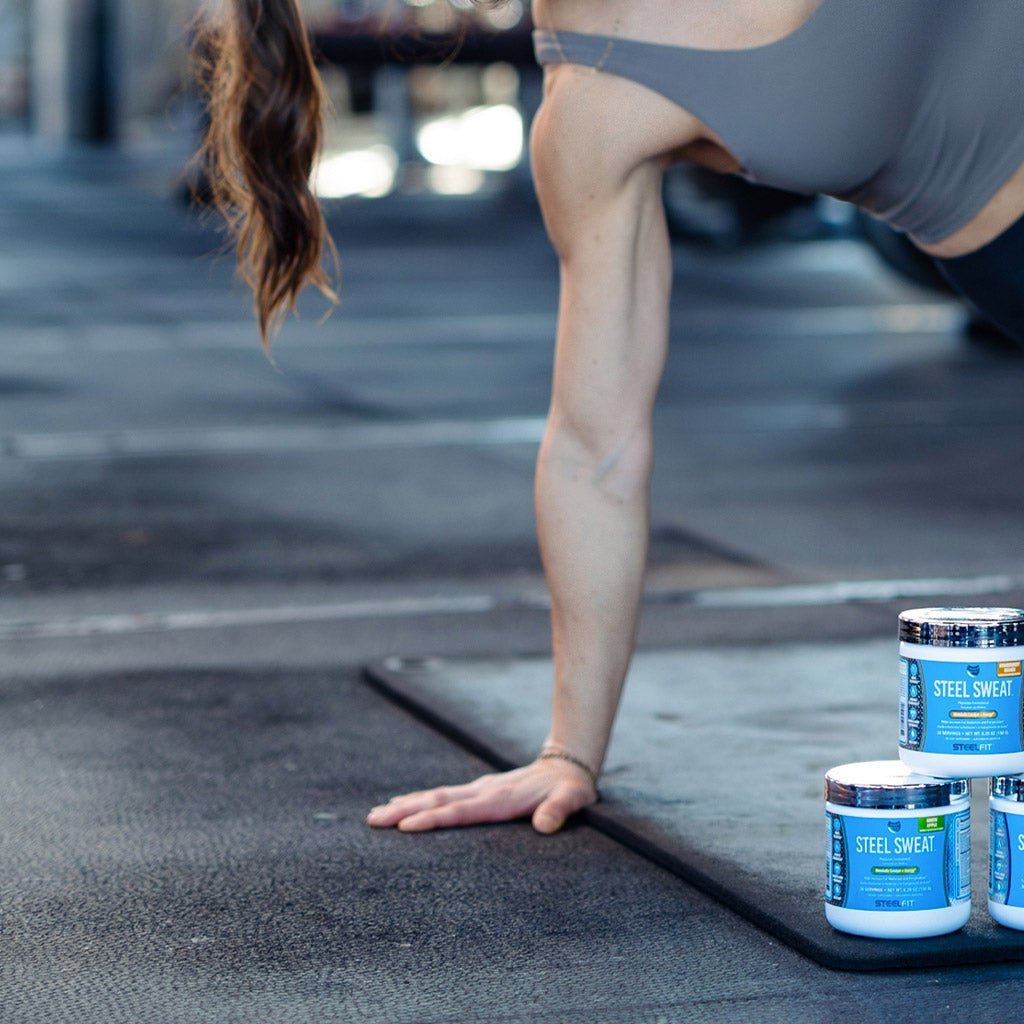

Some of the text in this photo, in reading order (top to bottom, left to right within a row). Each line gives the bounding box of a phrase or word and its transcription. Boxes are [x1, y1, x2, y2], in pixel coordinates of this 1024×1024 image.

[934, 680, 970, 698] STEEL
[973, 680, 1012, 698] SWEAT
[856, 835, 935, 854] STEEL SWEAT
